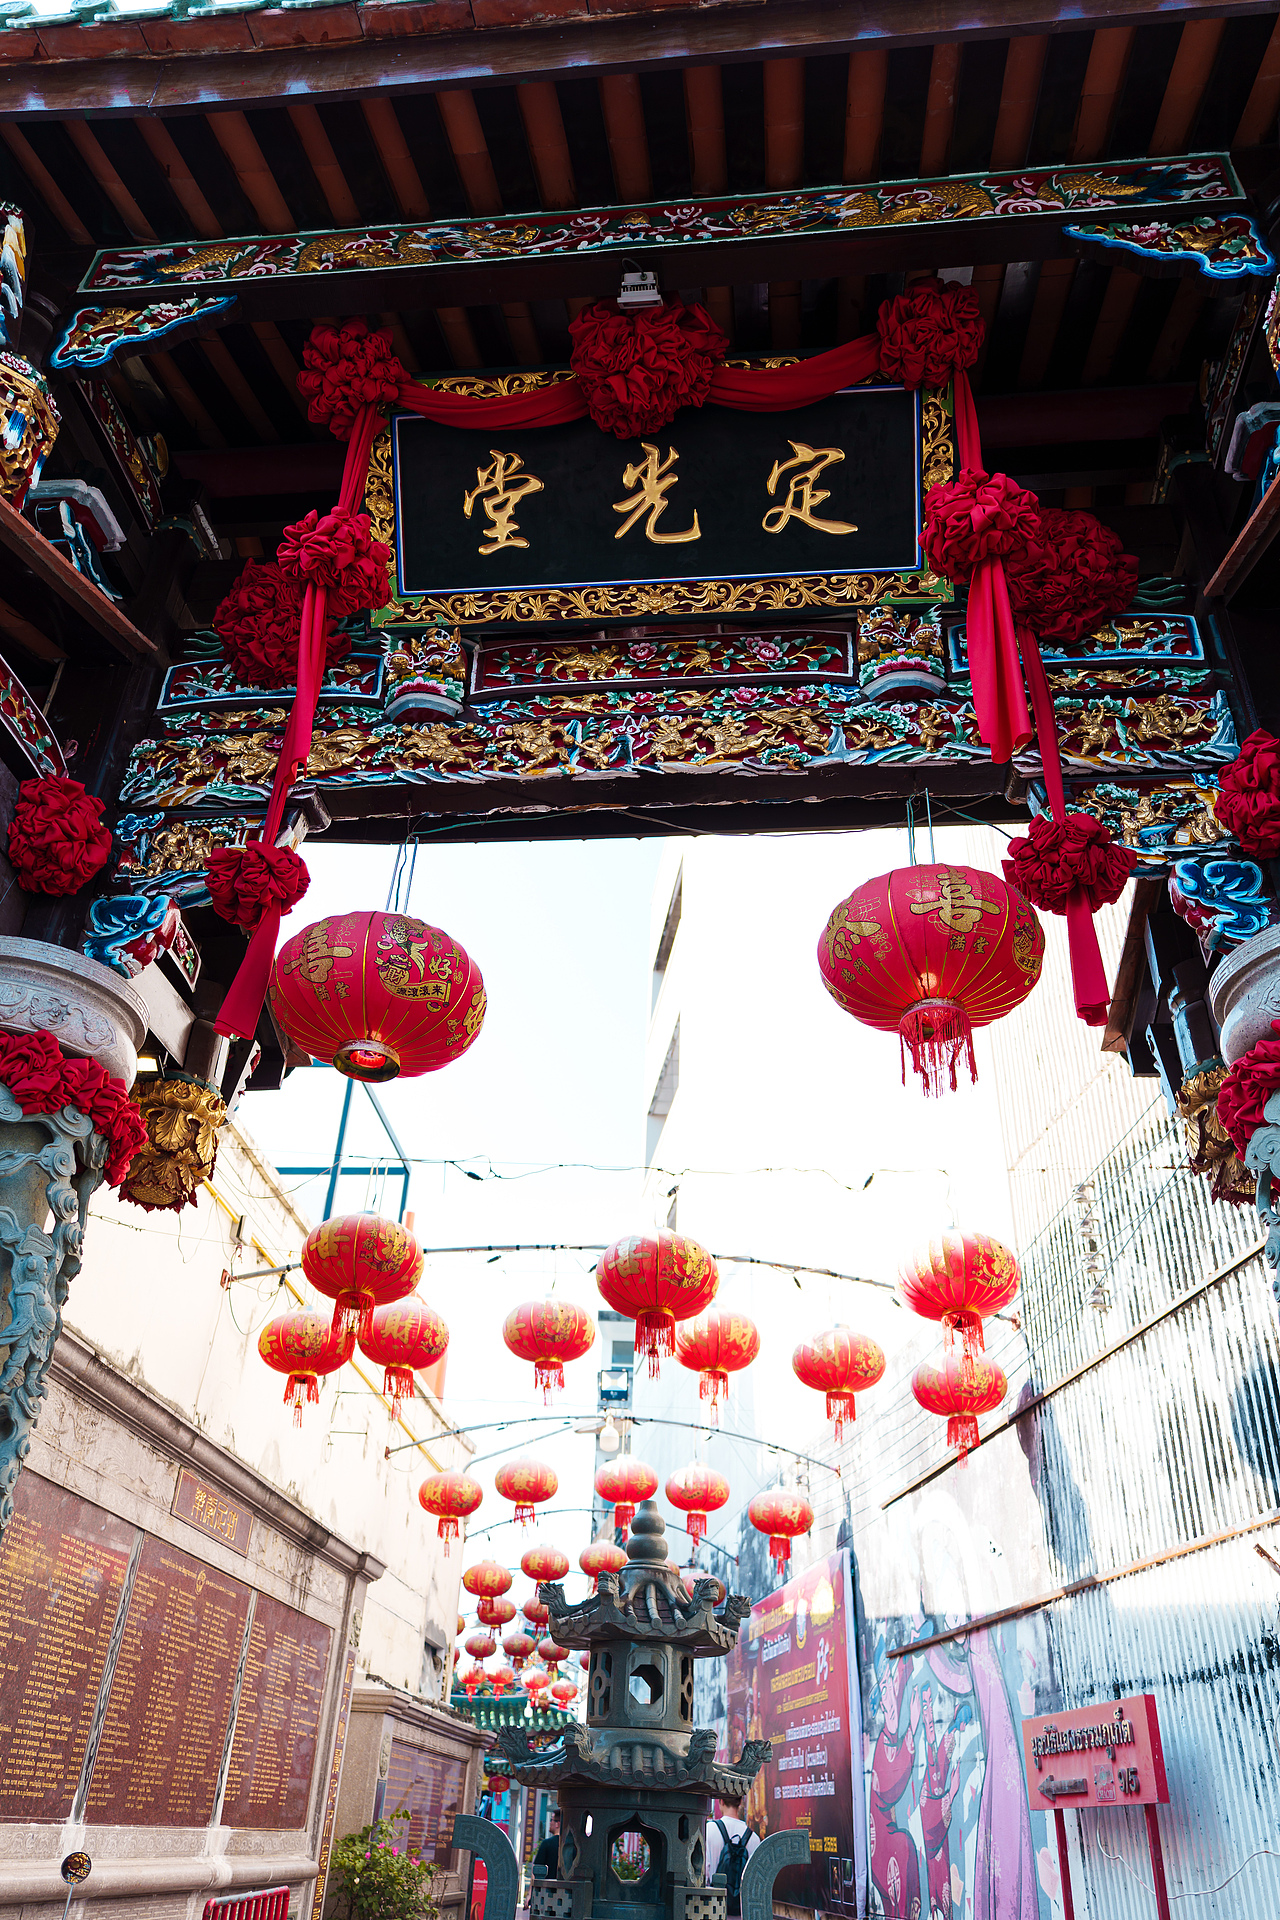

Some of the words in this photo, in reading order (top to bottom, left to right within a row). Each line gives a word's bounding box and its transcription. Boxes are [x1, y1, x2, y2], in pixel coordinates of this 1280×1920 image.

[909, 865, 1001, 934] 喜
[283, 919, 354, 984] 喜
[380, 1310, 417, 1345] 財
[726, 1317, 754, 1351] 財
[424, 1480, 445, 1503] 財
